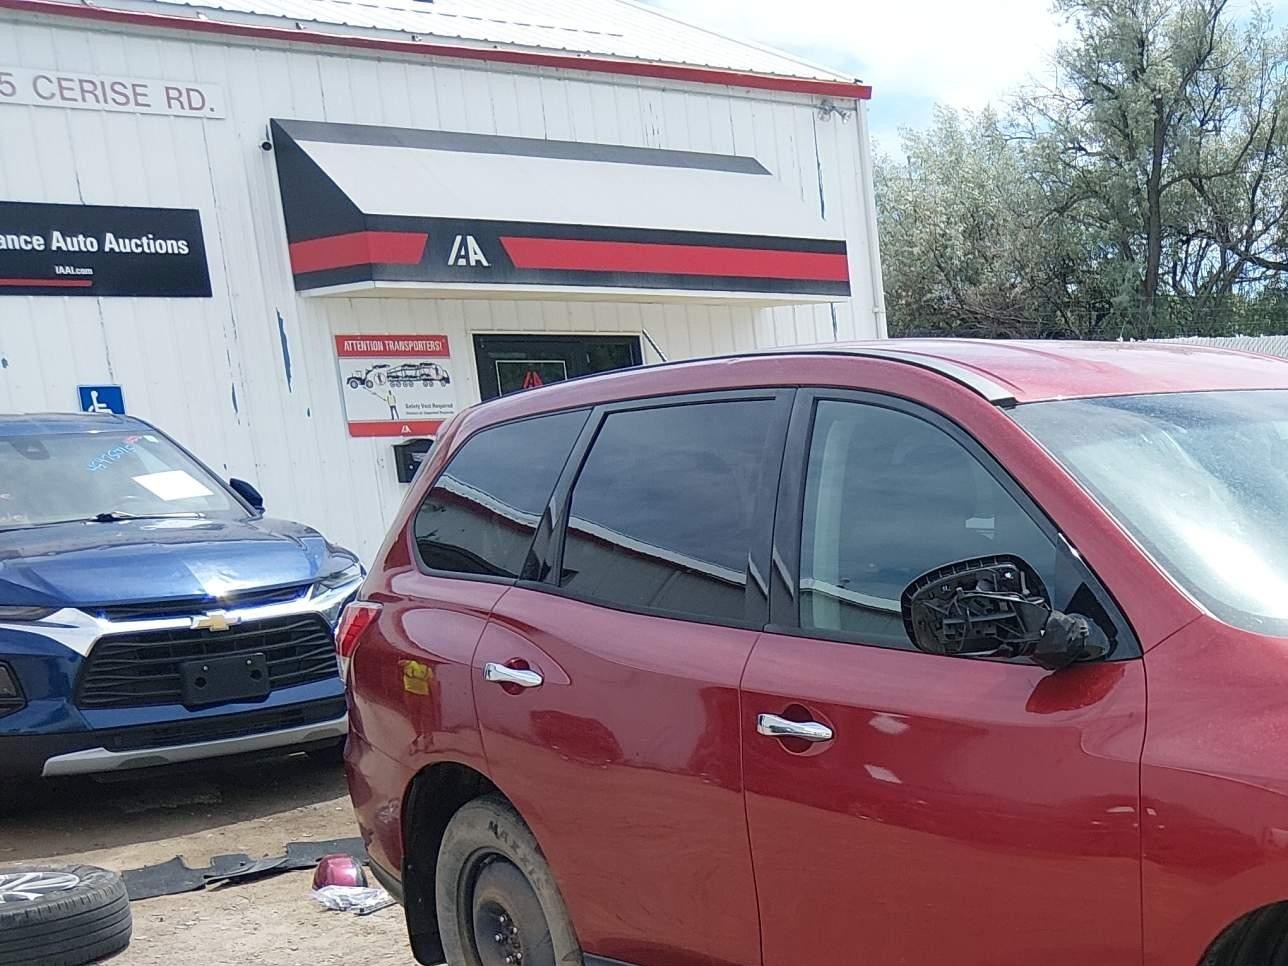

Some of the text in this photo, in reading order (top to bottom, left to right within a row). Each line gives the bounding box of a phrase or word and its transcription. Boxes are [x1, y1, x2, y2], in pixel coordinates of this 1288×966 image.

[32, 75, 151, 107] CERISE
[164, 86, 215, 112] RD.
[51, 231, 98, 251] Auto
[104, 232, 189, 254] Auctions
[344, 340, 443, 352] ATTENTION TRANSPORTERS!
